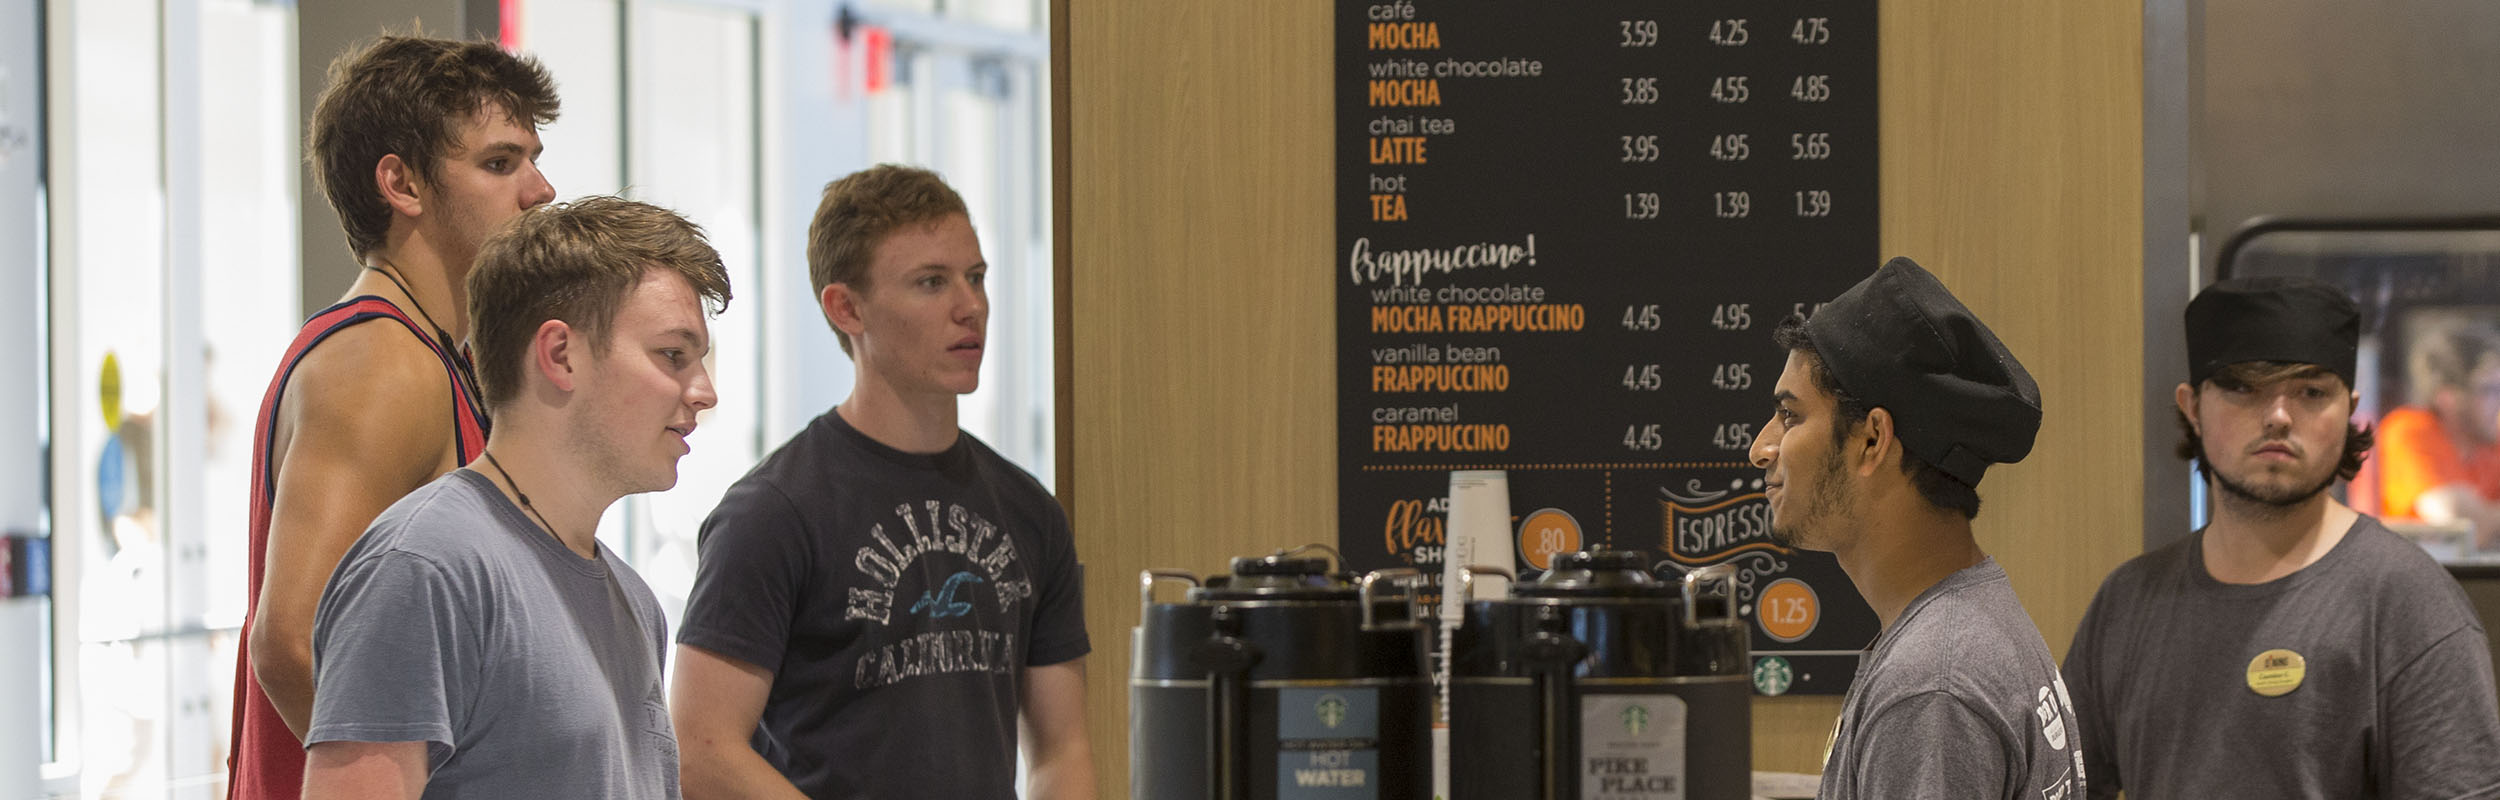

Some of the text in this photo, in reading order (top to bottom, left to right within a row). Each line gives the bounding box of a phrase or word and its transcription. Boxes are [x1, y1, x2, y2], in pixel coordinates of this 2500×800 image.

[1368, 0, 1416, 20] café
[1368, 21, 1441, 50] MOCHA
[1620, 17, 1830, 47] 3.59 4.25 4.75
[1369, 57, 1543, 78] white chocolate
[1368, 78, 1441, 107] MOCHA
[1622, 75, 1830, 105] 3.85 4.55 4.85
[1369, 115, 1455, 135] chai tea
[1369, 136, 1427, 165] LATTE
[1622, 132, 1831, 162] 3.95 4.95 5.65
[1370, 173, 1407, 192] hot
[1369, 194, 1409, 222] TEA
[1625, 190, 1831, 219] 1.39 1.39 1.39
[1350, 233, 1537, 287] frappuccino!
[1371, 283, 1545, 303] white chocolate
[1371, 303, 1585, 333] MOCHA FRAPPUCCINO
[1622, 303, 1751, 331] 4.45 4.95
[1372, 343, 1501, 363] vanilla bean
[1372, 364, 1510, 393] FRAPPUCCINO
[1623, 363, 1752, 391] 4.45 4.95
[1372, 403, 1459, 423] caramel
[1372, 423, 1510, 452] FRAPPUCCINO
[1623, 423, 1753, 450] 4.45 4.95
[1535, 527, 1565, 555] .80
[845, 500, 1032, 625] HOLLISTER
[1771, 597, 1808, 624] 1.25
[854, 629, 1014, 690] CALIFORNIA
[1310, 751, 1350, 768] HOT
[1589, 757, 1648, 775] PIKE
[1295, 769, 1365, 787] WATER
[1601, 776, 1676, 794] PLACE
